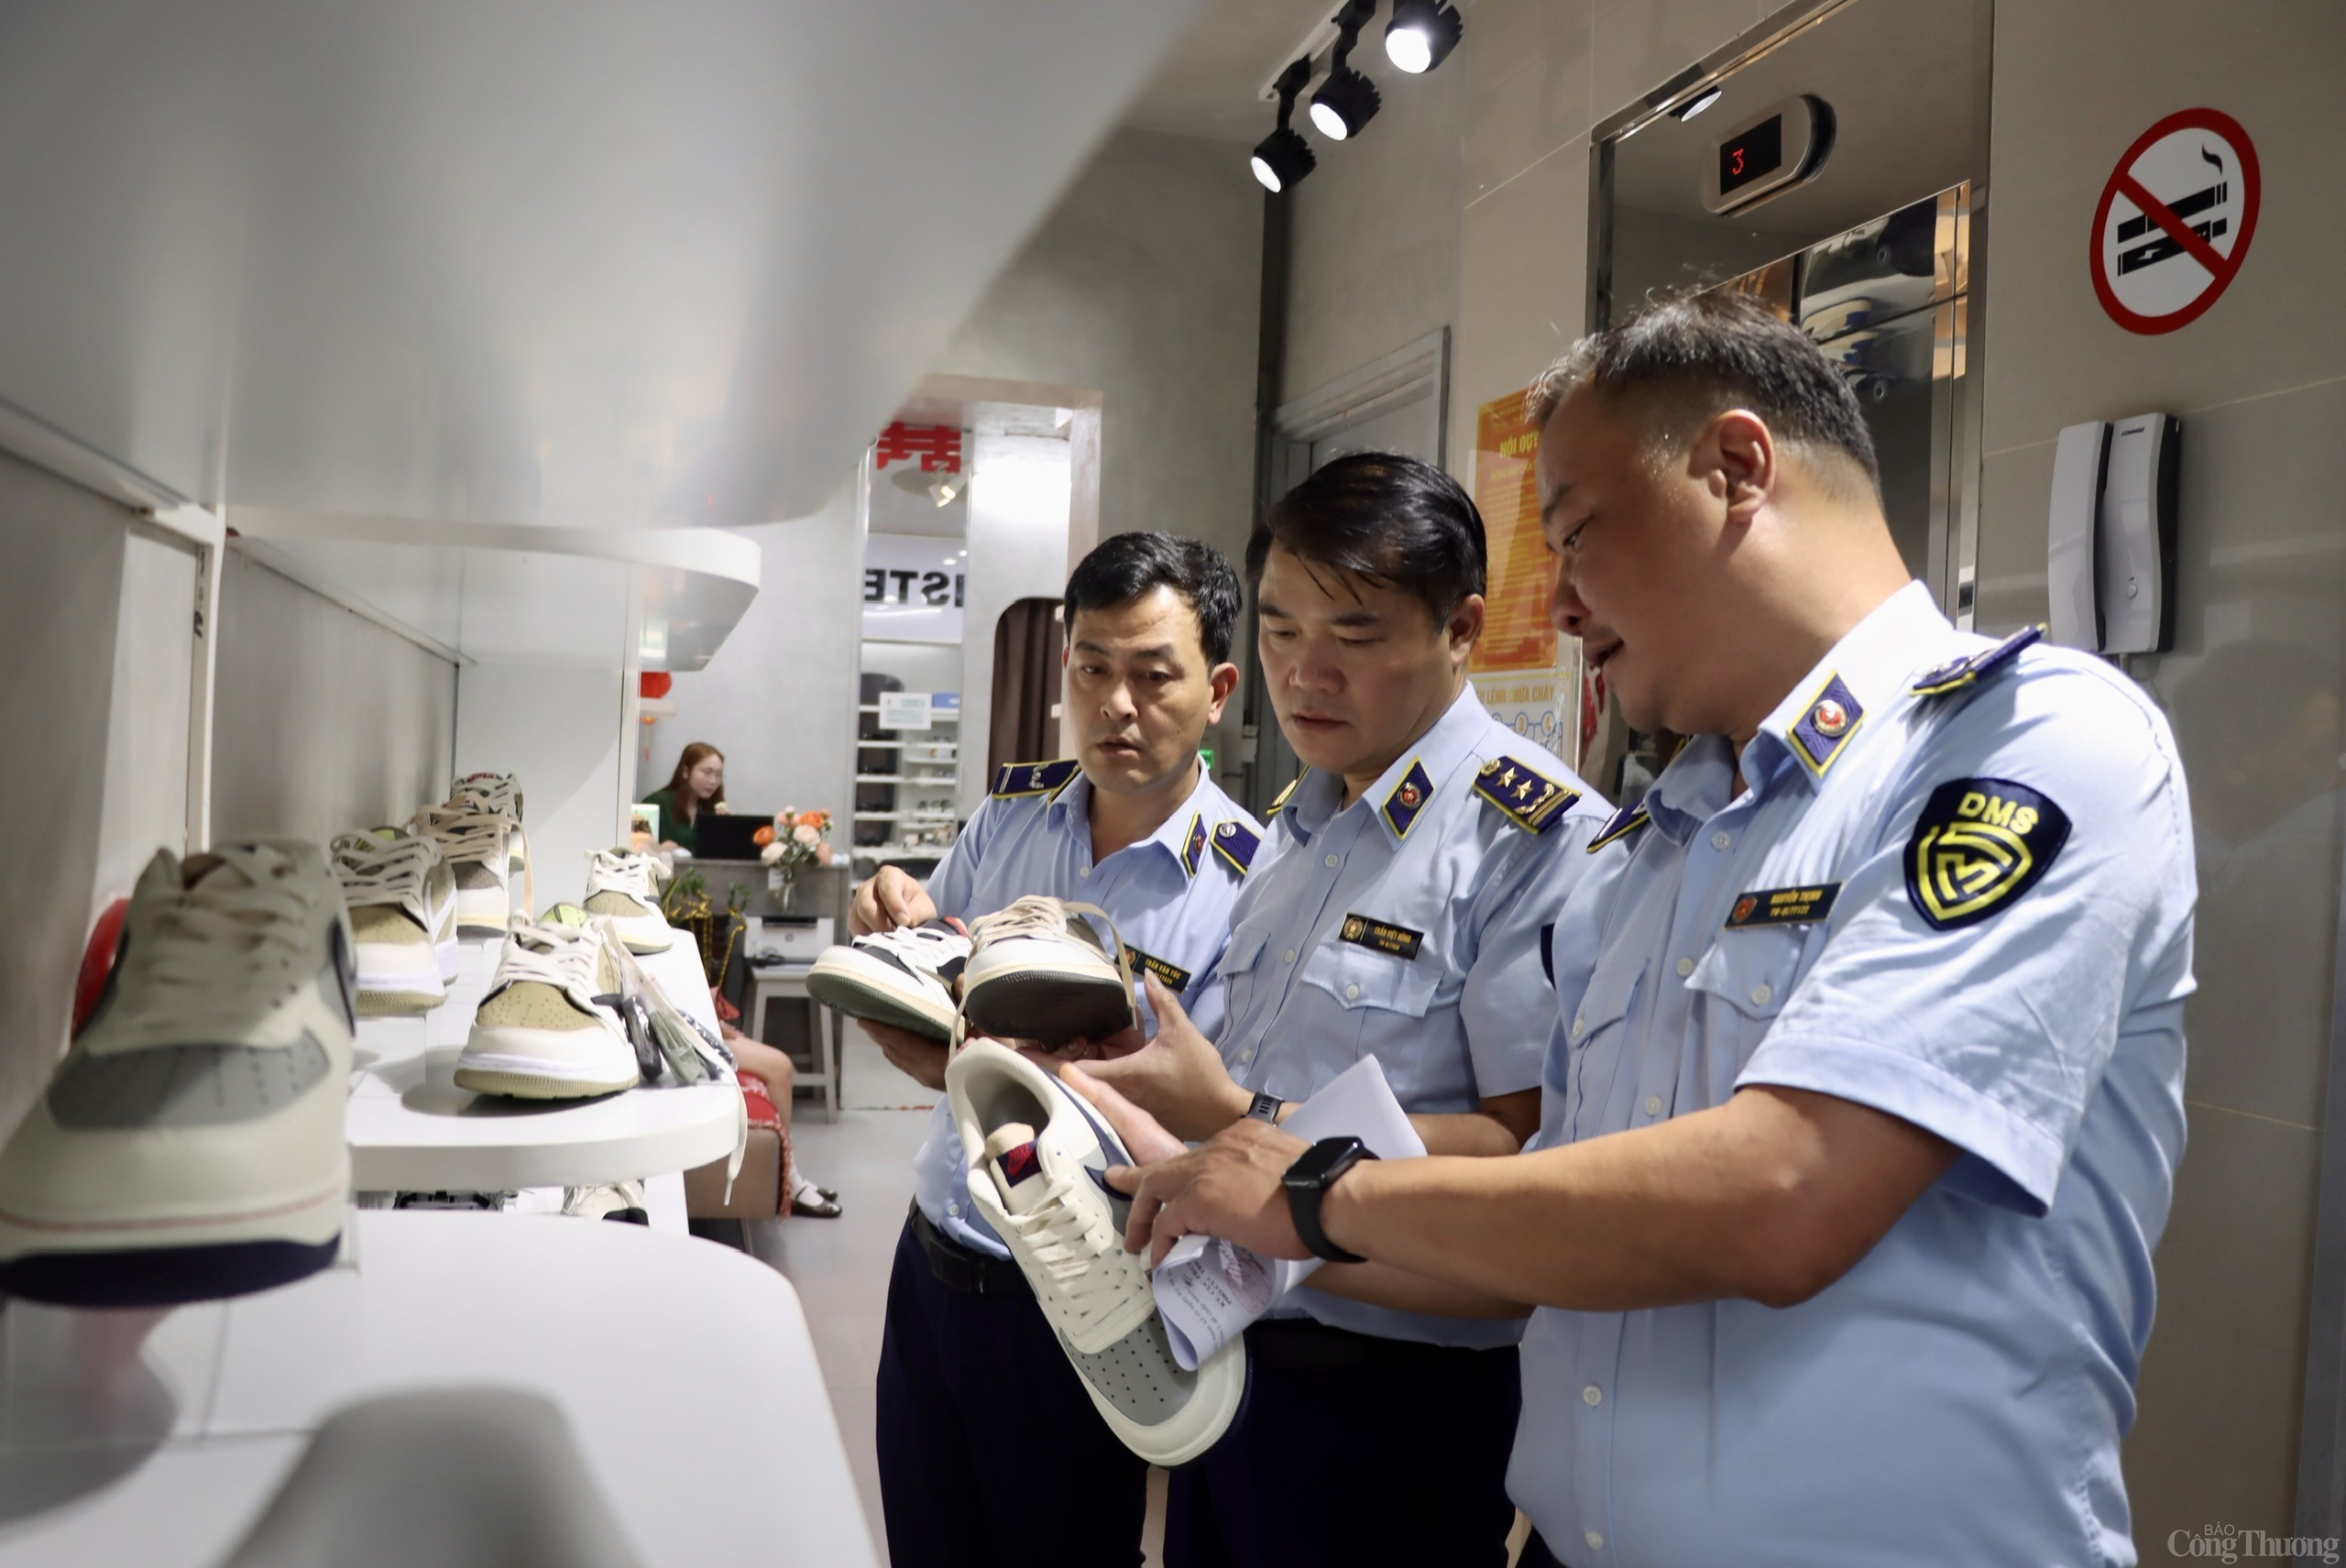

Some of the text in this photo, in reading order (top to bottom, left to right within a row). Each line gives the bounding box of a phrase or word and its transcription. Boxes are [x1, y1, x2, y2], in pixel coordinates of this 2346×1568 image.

[1732, 148, 1744, 175] 3
[1486, 685, 1507, 707] LỆNH
[1509, 684, 1530, 704] CHỮA
[1957, 792, 2039, 835] DMS
